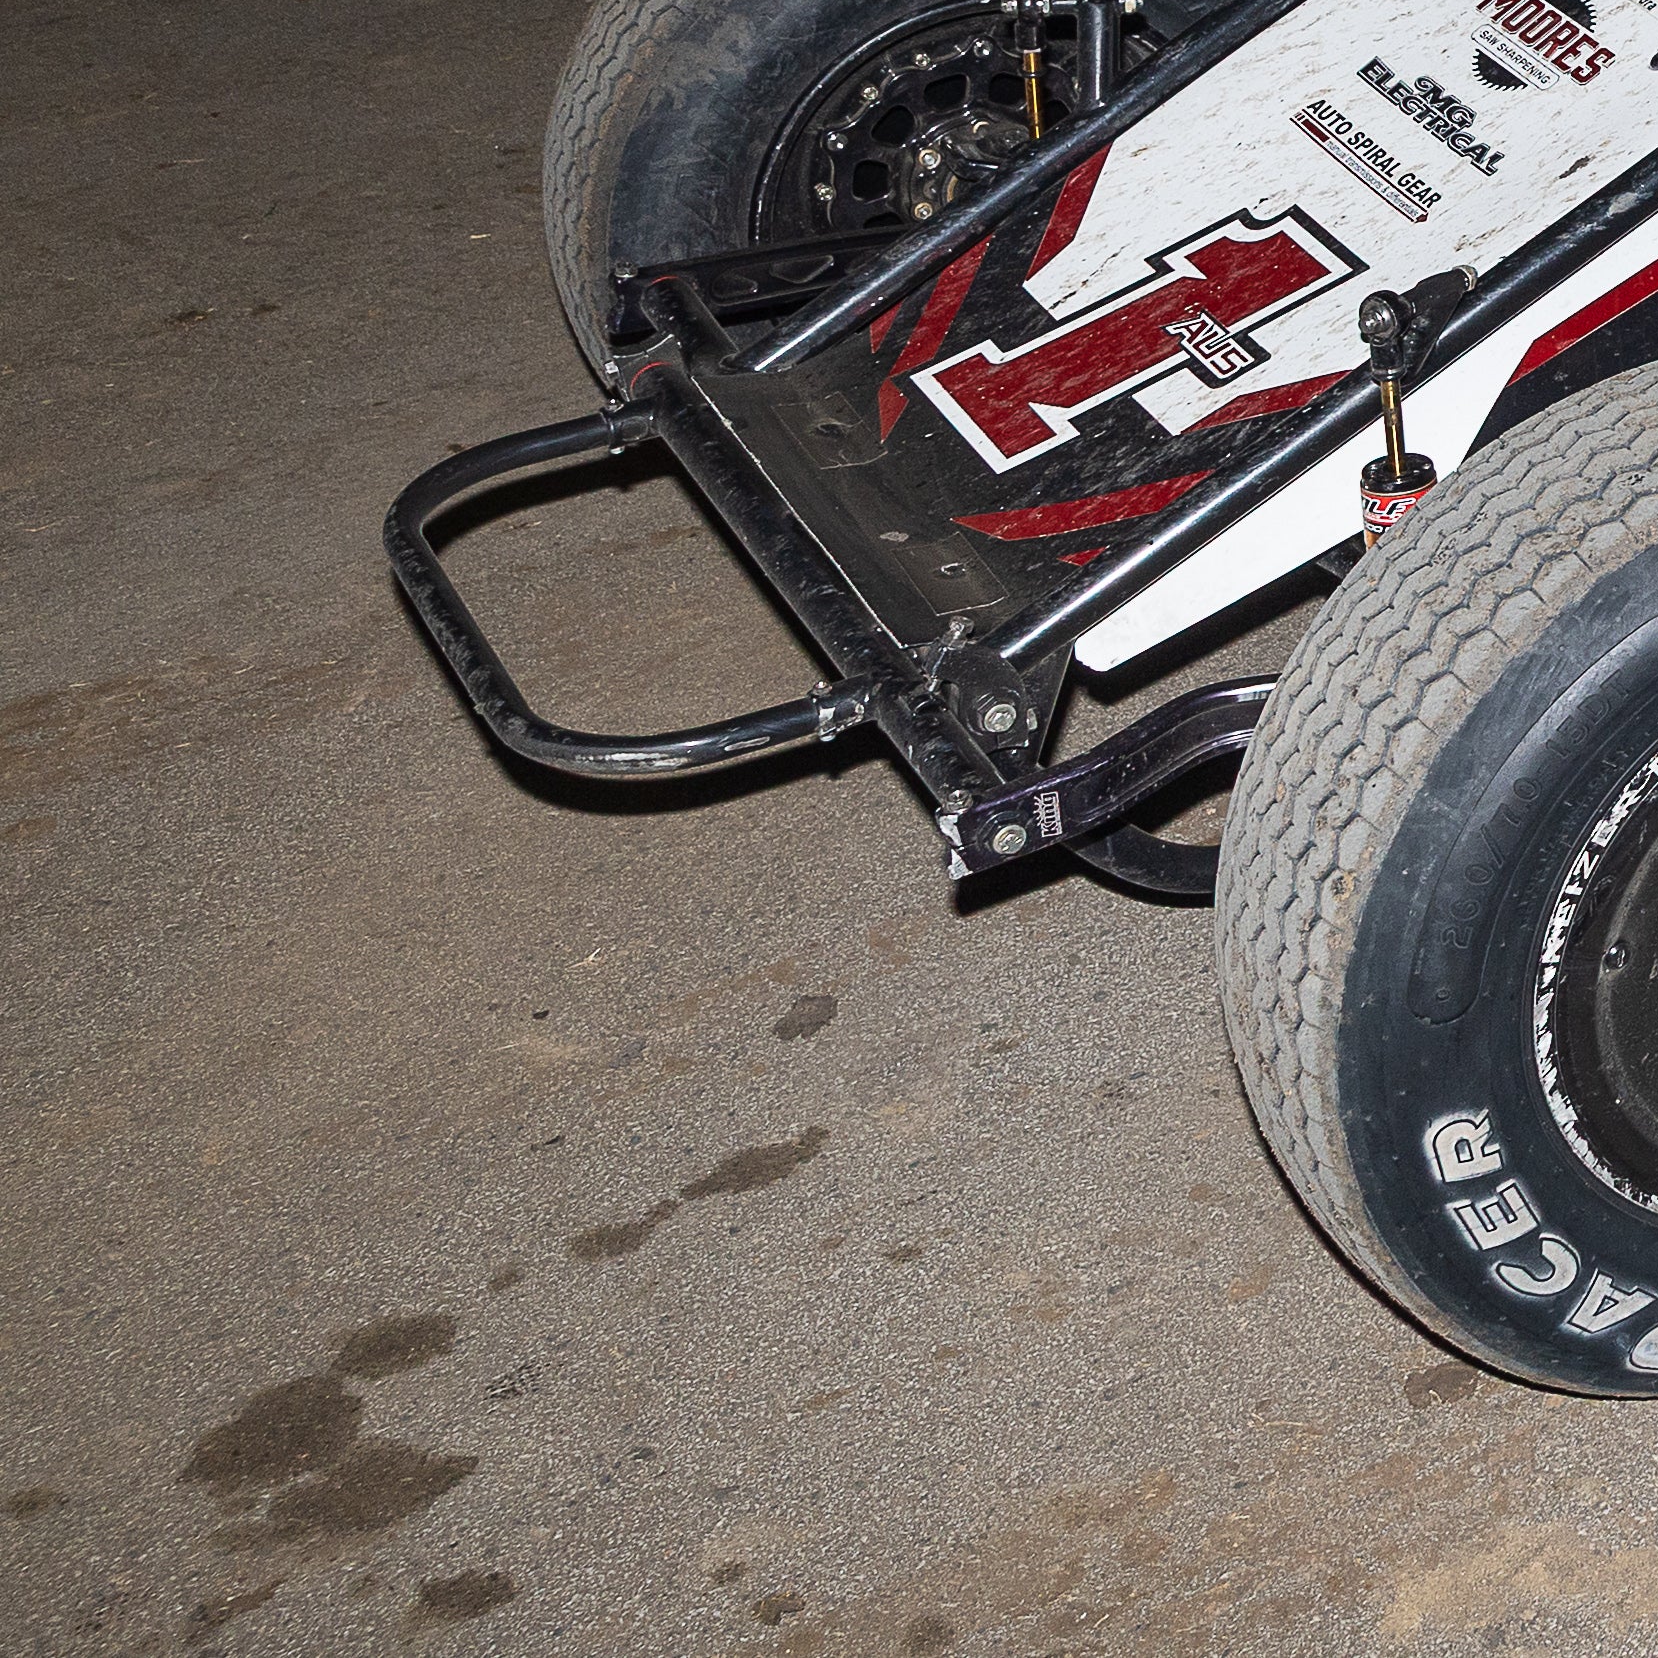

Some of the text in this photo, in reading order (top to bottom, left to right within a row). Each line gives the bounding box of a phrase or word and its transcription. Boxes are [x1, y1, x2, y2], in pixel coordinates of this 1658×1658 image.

[1478, 28, 1552, 86] SAW SHARPENING
[1306, 99, 1442, 209] AUTO SPIRAL GEAR
[1356, 55, 1506, 177] ELECTRICAL
[909, 214, 1353, 475] 1
[1166, 311, 1260, 382] AUS
